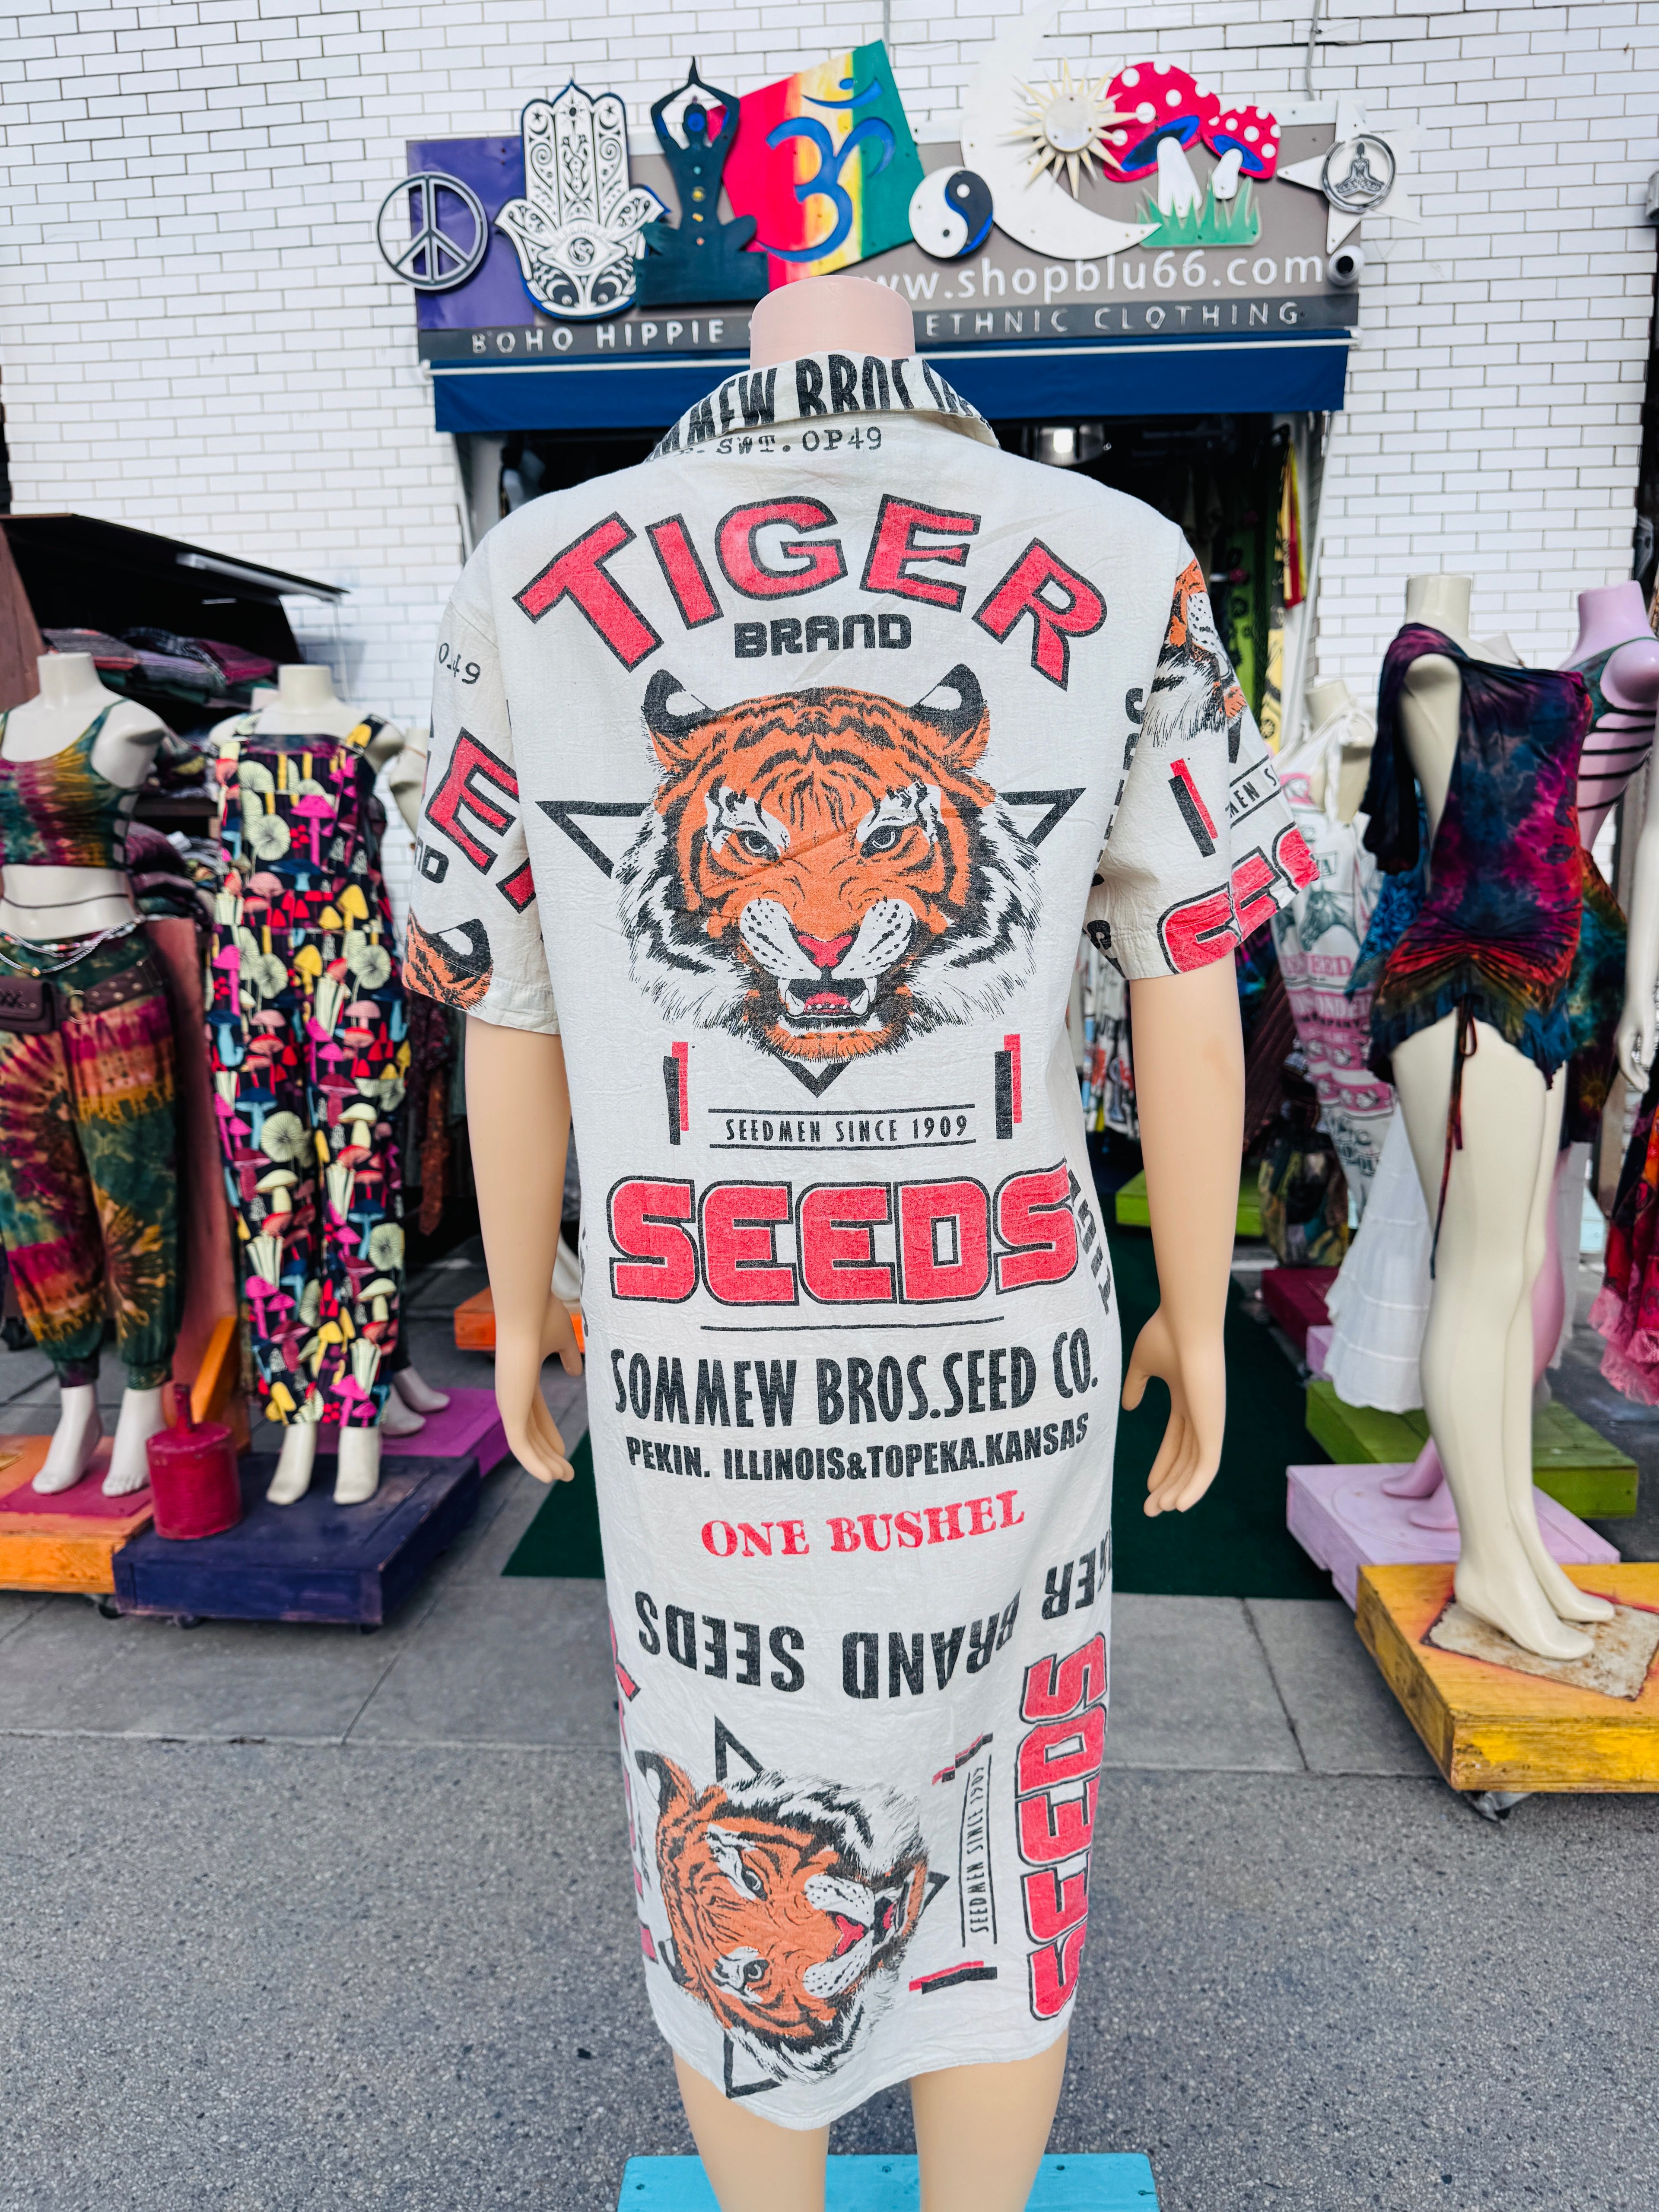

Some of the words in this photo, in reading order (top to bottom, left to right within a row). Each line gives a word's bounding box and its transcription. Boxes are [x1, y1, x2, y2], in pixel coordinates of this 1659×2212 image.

[472, 328, 573, 353] BOHO
[596, 320, 724, 349] HIPPIE
[926, 309, 1069, 337] ETHNIC
[1094, 301, 1298, 331] CLOTHING
[512, 493, 1107, 692] TIGER
[734, 613, 912, 658] BRAND
[726, 1119, 820, 1142] SEEDMEN
[836, 1119, 897, 1142] SINCE
[912, 1115, 967, 1139] 1909
[606, 1157, 1079, 1307] SEEDS
[610, 1348, 797, 1428] SOMMEW
[1052, 1328, 1098, 1398] CO.
[626, 1436, 711, 1478] PEKIN.
[701, 1519, 810, 1557] ONE
[826, 1490, 1025, 1553] BUSHEL
[635, 1591, 804, 1692] SEEDS
[842, 1589, 1020, 1699] BRAND
[967, 1808, 984, 1854] SINCE
[966, 1862, 989, 1933] SEEDMEN
